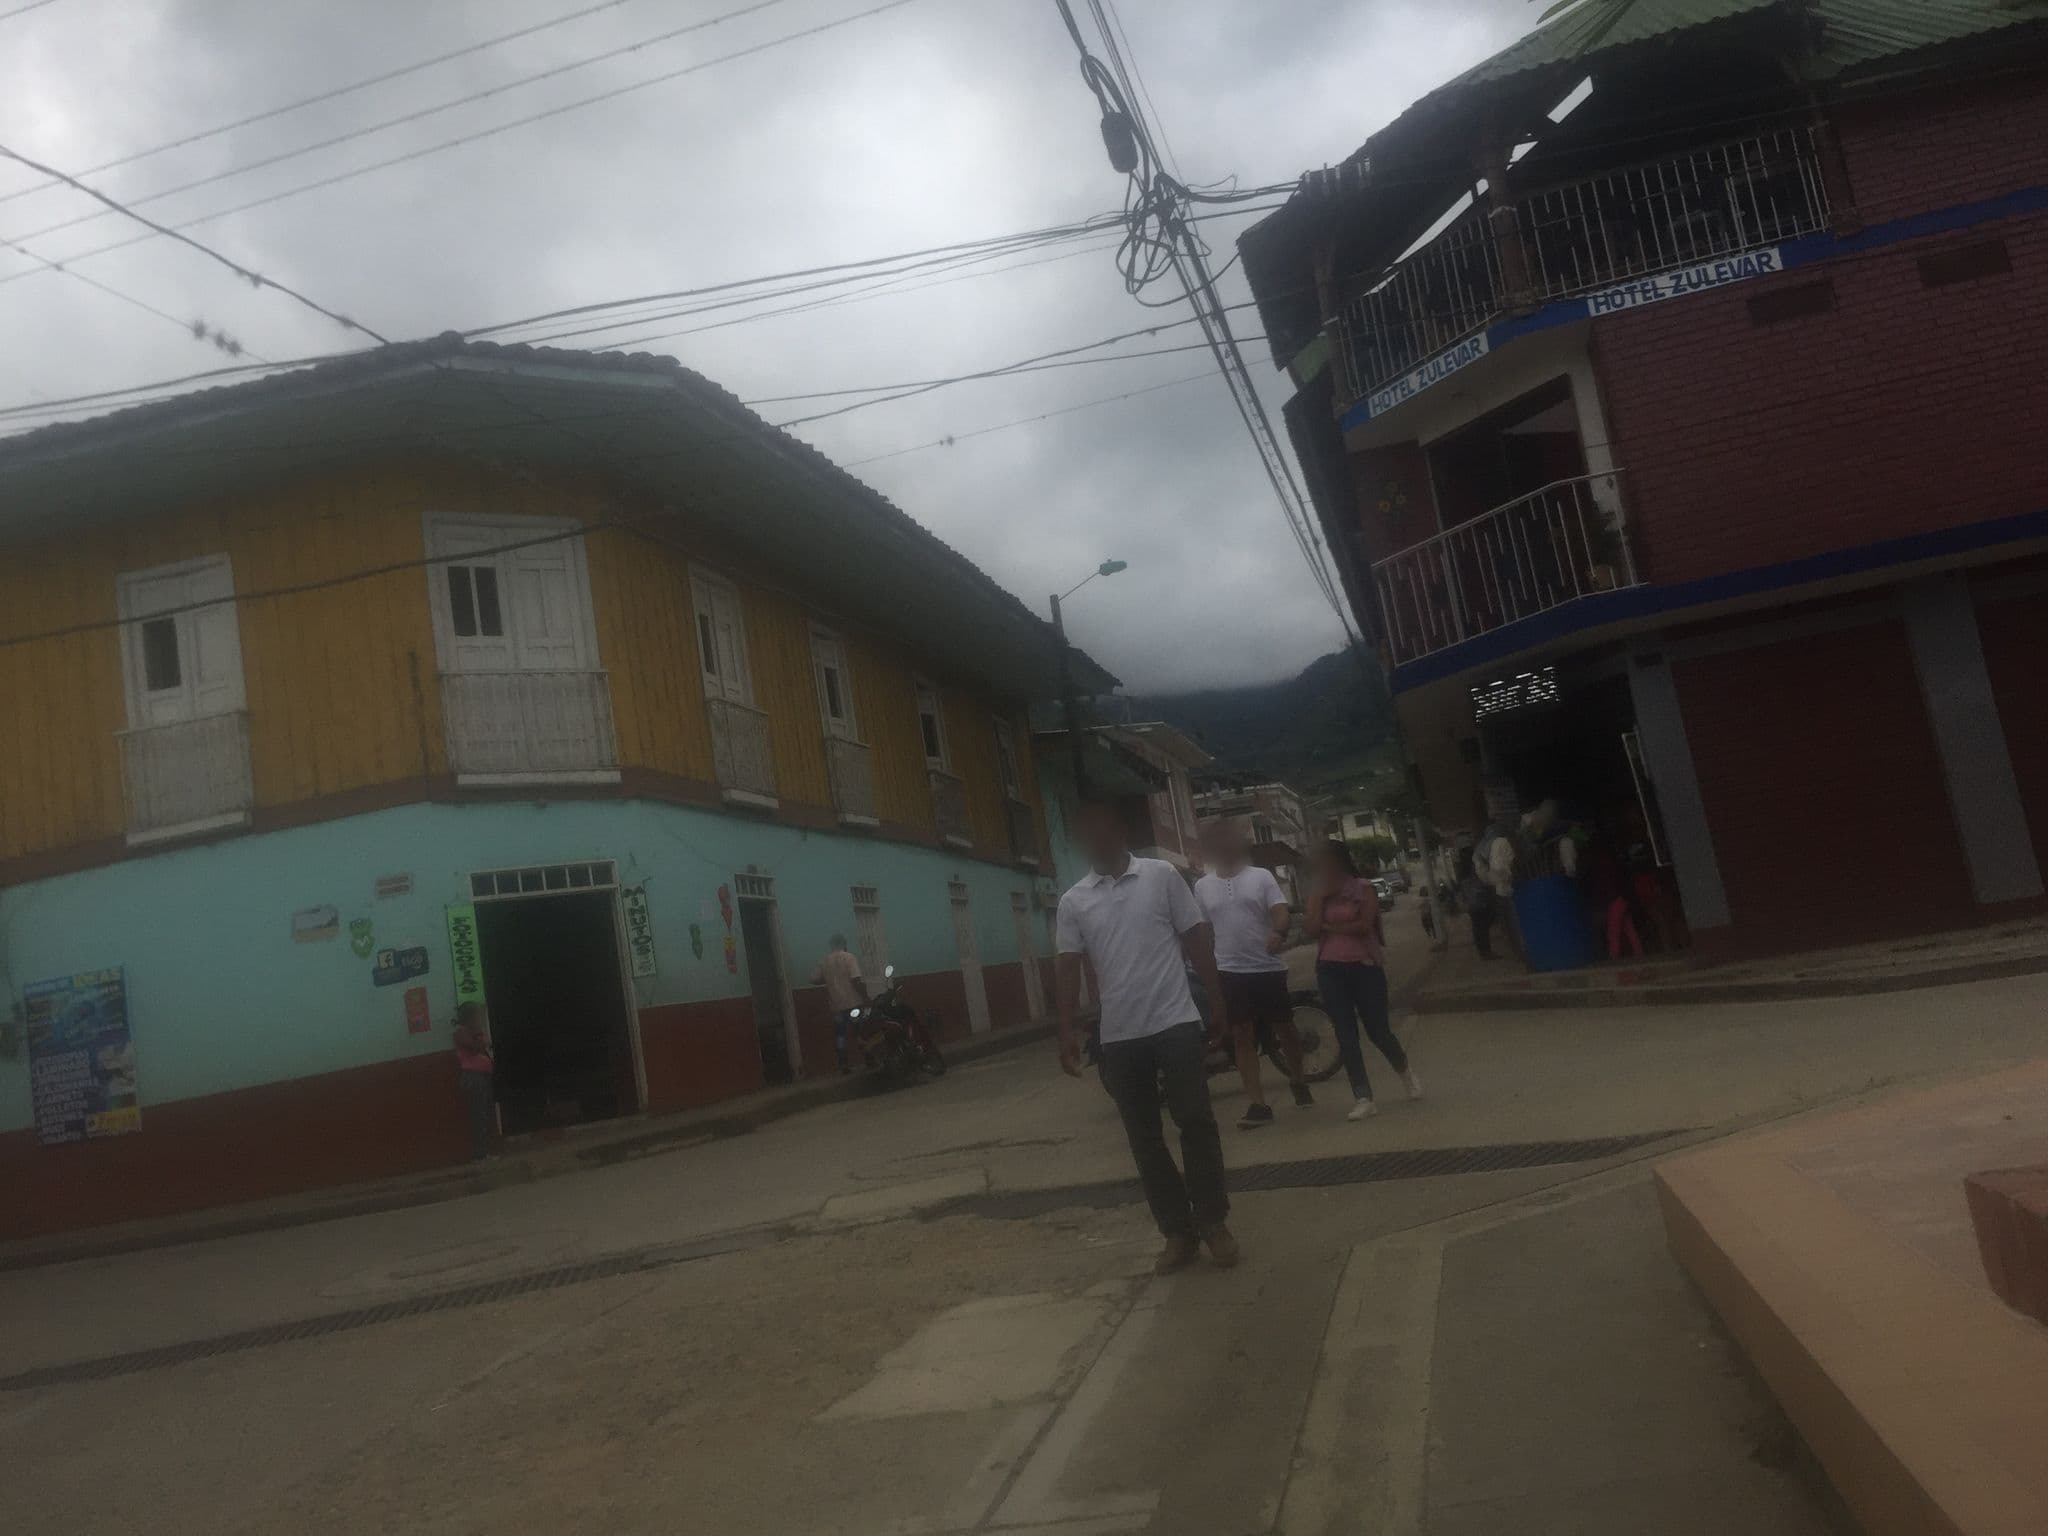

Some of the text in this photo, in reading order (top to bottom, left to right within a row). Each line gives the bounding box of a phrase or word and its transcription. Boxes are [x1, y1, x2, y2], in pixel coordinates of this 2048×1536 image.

[1593, 252, 1776, 314] HOTEL ZULEVAR
[1370, 336, 1484, 414] HOTEL ZULEVAR
